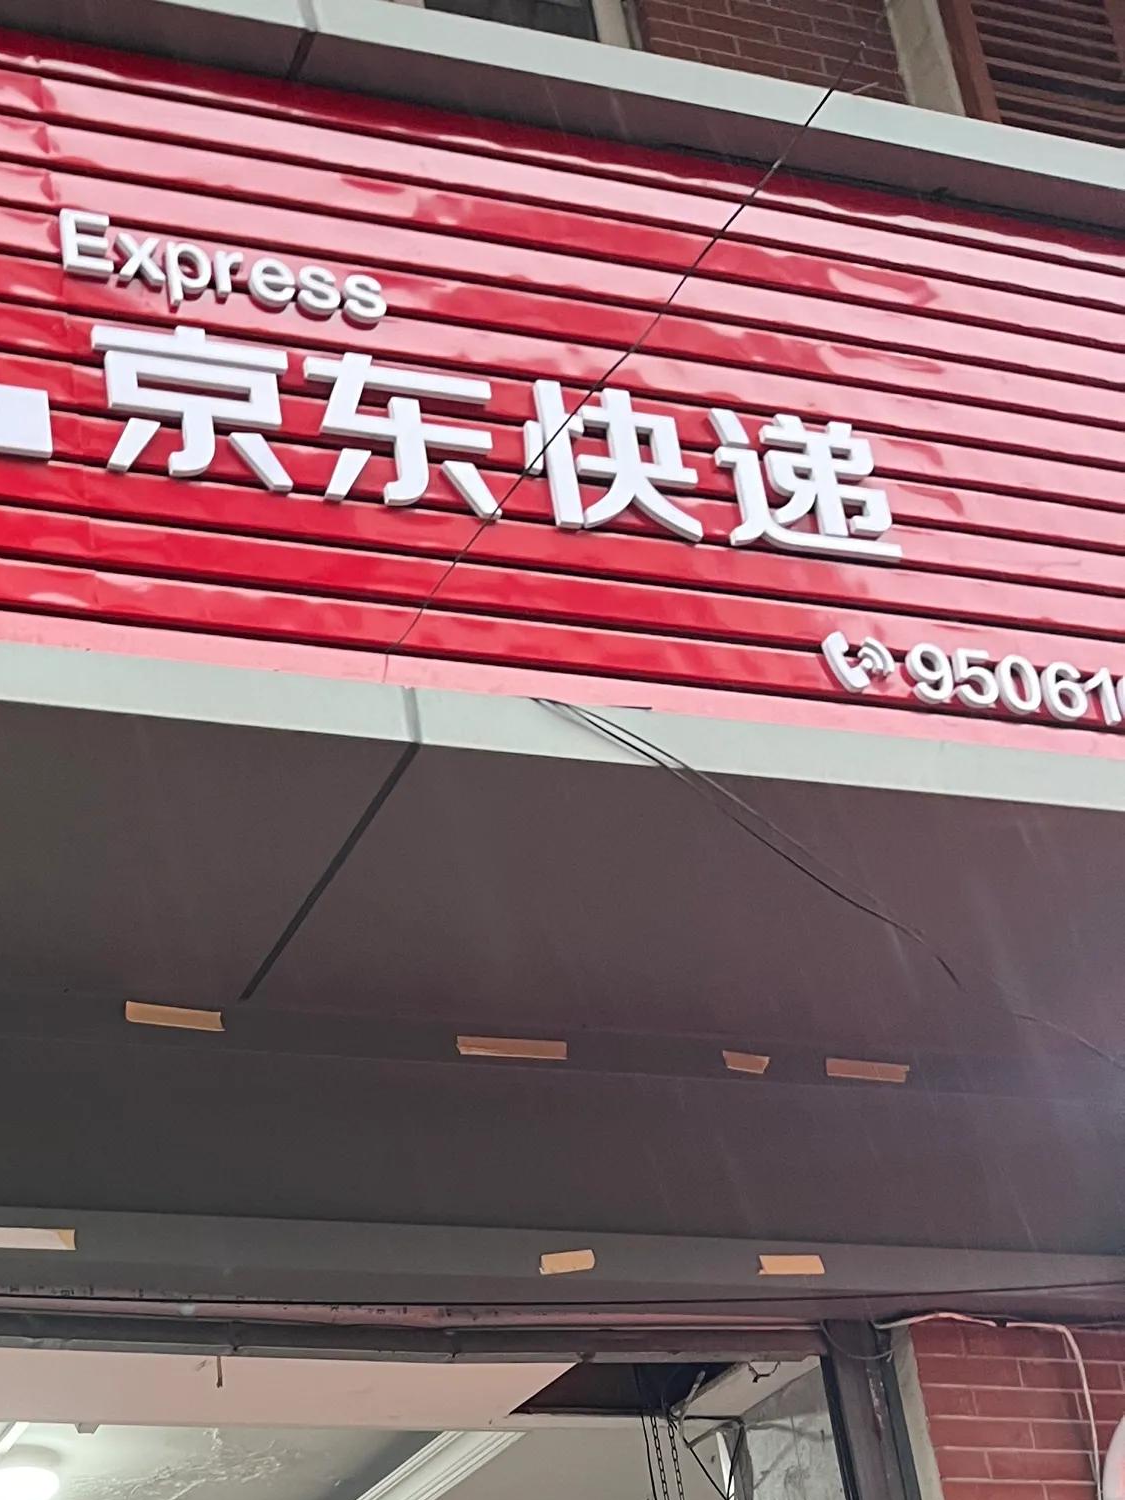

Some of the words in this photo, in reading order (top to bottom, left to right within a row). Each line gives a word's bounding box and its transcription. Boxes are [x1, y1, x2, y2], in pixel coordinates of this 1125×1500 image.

[59, 208, 388, 325] Express
[91, 325, 903, 561] 京东快递
[905, 642, 1125, 727] 95061
